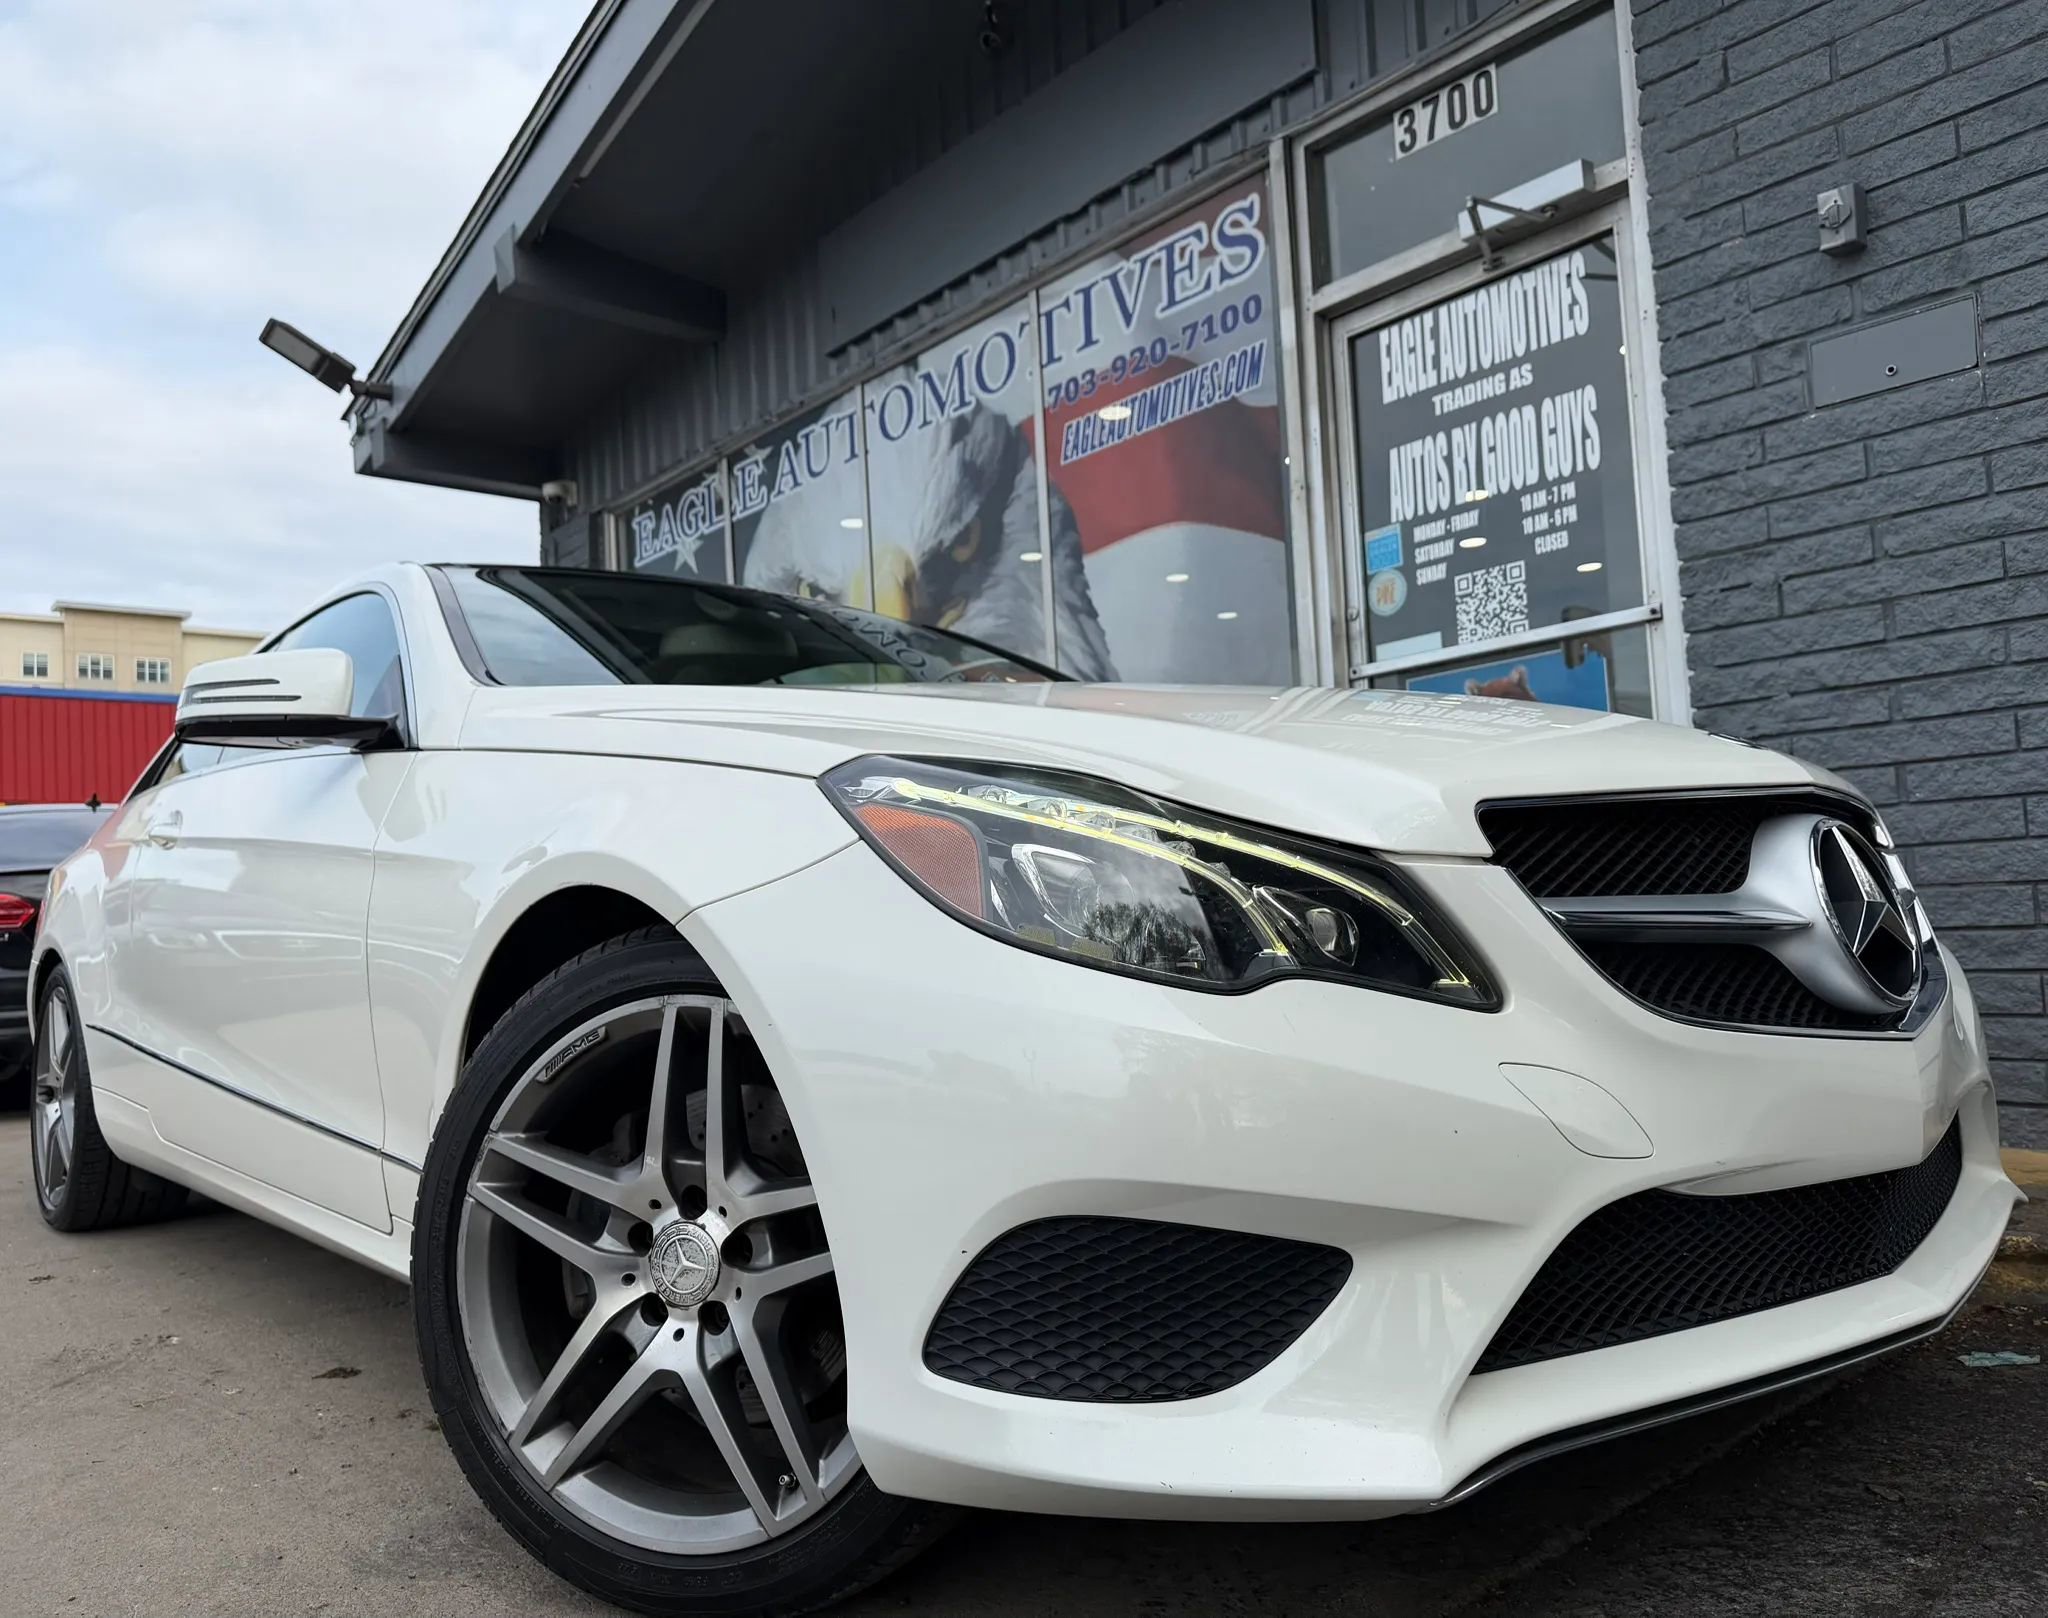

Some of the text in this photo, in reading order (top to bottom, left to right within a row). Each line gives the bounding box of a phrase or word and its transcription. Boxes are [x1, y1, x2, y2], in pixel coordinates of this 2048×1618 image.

[1398, 69, 1494, 154] 3700
[1048, 294, 1263, 412] 703-920-7100
[1379, 251, 1590, 405] EAGLE AUTOMOTIVES
[632, 193, 1266, 567] EAGLE AUTOMOTIVES
[1060, 338, 1268, 466] EAGLEAUTOMOTIVES.COM
[1432, 363, 1533, 416] TRADING AS
[1389, 384, 1600, 523] AUTOS BY GOOD GUYS
[1520, 493, 1532, 513] 10
[1532, 489, 1548, 510] AM
[1552, 485, 1559, 504] 7
[1560, 481, 1577, 502] PM
[1522, 516, 1533, 535] 10
[1534, 511, 1549, 533] AM
[1554, 508, 1562, 527] 6
[1562, 503, 1578, 525] PM
[1413, 518, 1446, 543] MONDAY
[1450, 508, 1480, 533] FRIDAY
[1414, 538, 1455, 565] SATURDAY
[1534, 529, 1570, 555] CLOSED
[1415, 561, 1447, 587] SUNDAY
